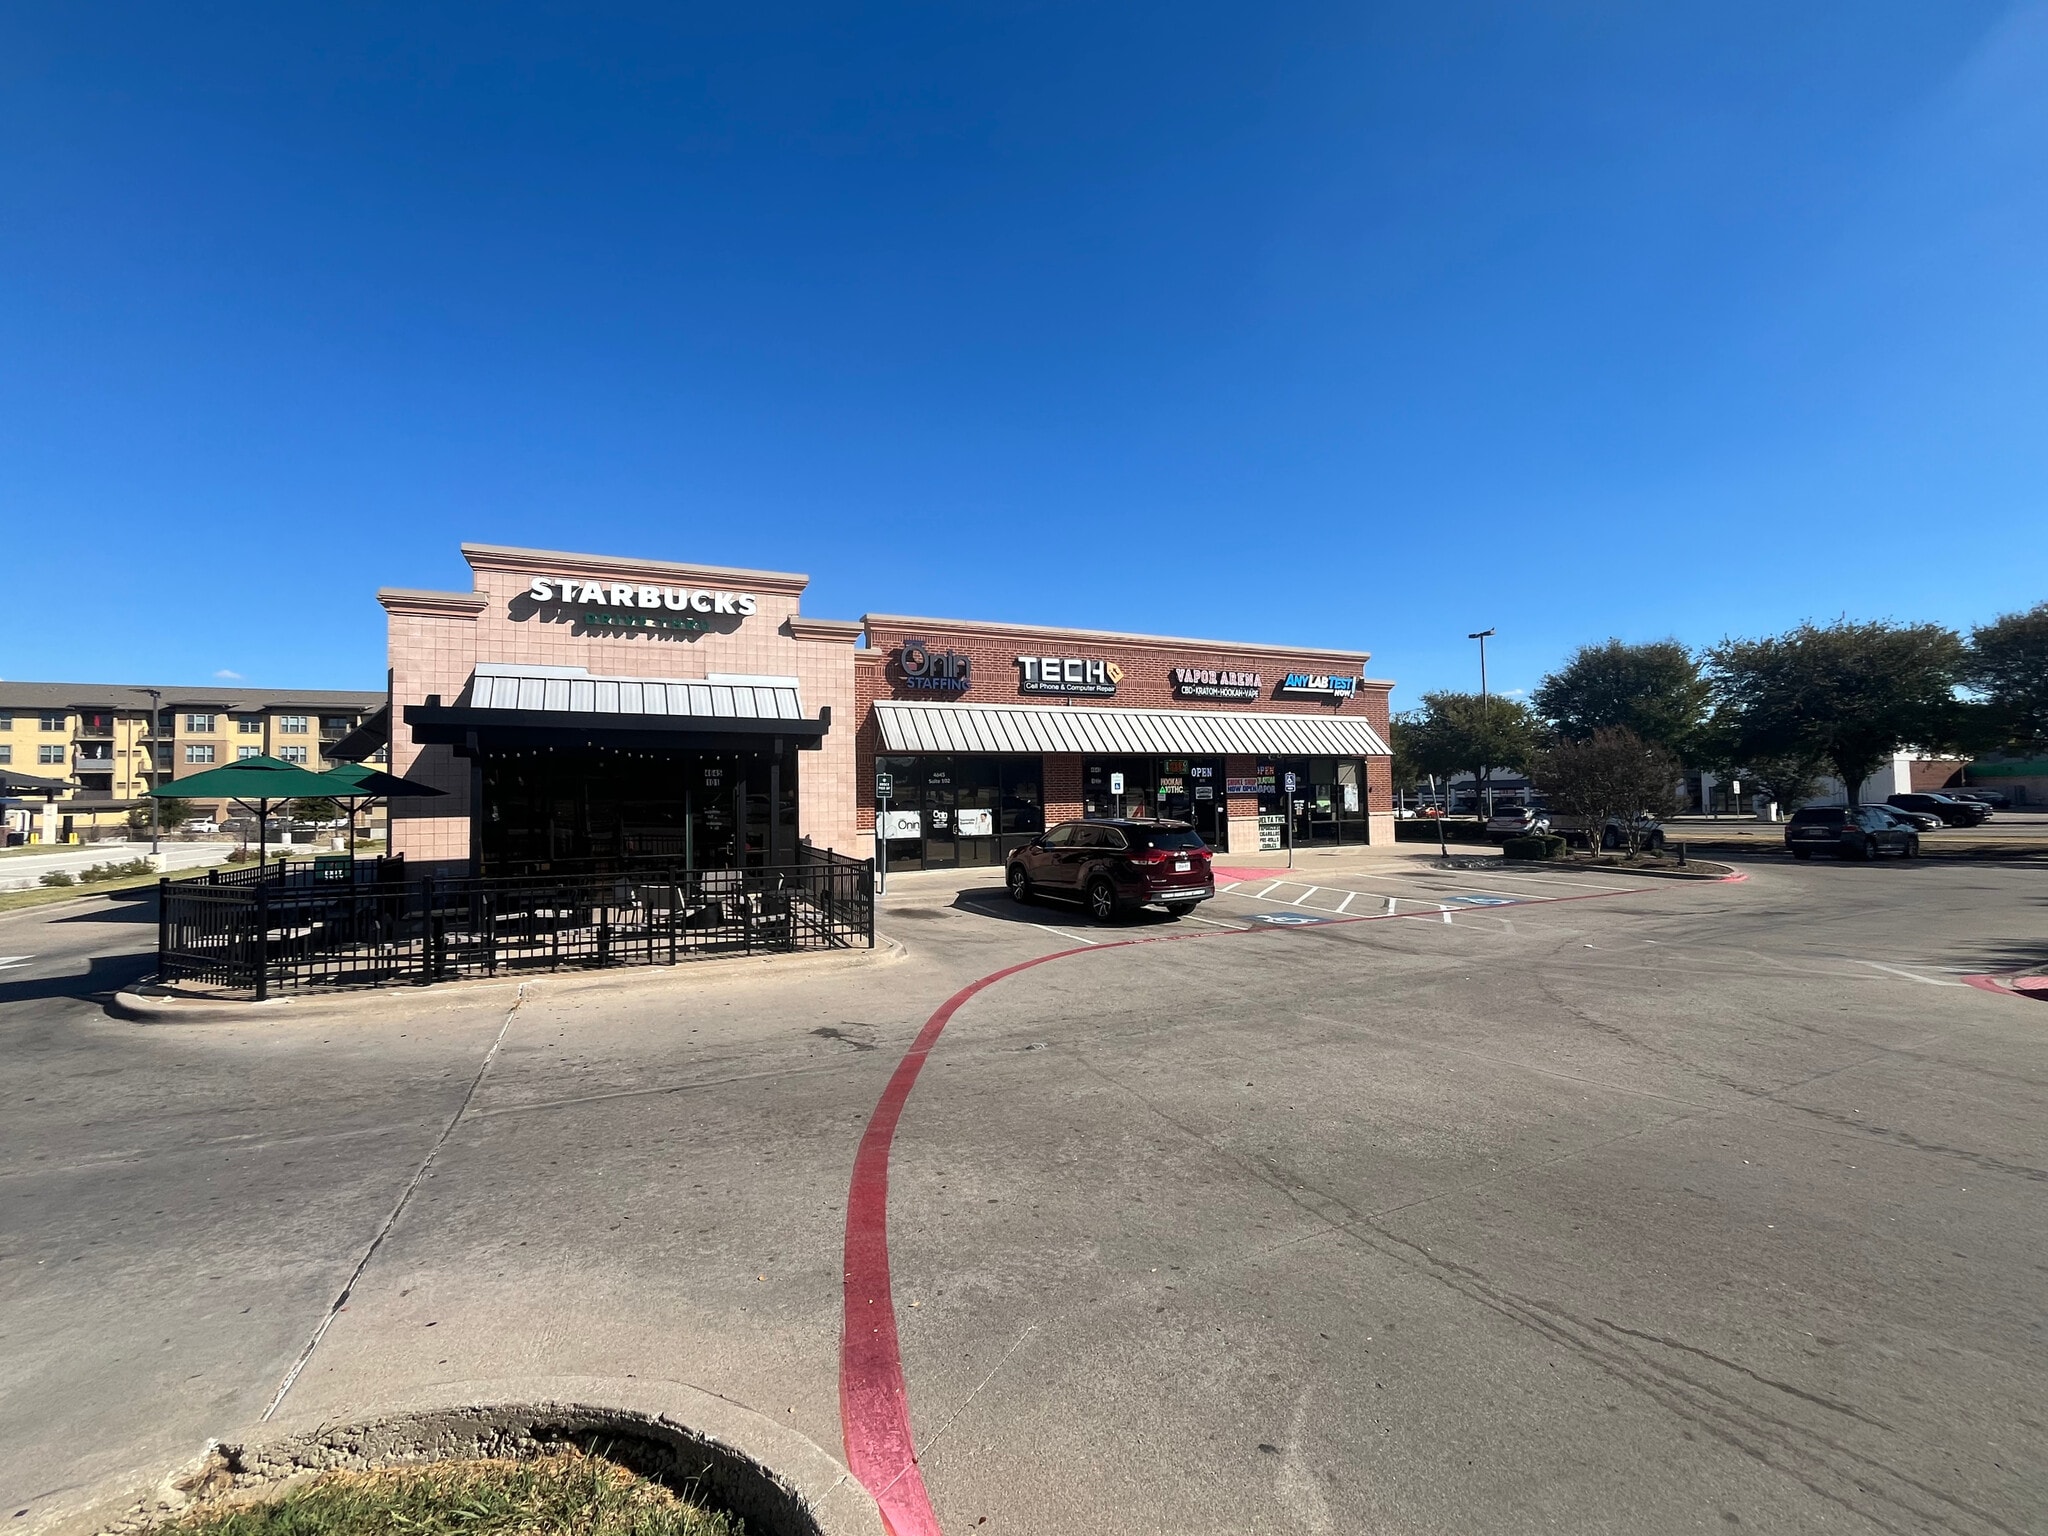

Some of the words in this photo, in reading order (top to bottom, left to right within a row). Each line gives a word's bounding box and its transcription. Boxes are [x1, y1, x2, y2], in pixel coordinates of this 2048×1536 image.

[530, 577, 757, 616] STARBUCKS
[1018, 656, 1105, 683] TECH
[1176, 668, 1218, 685] VAPOR
[1220, 671, 1263, 688] ARENA
[906, 676, 971, 691] STAFFING
[1026, 682, 1038, 690] Cell
[1040, 683, 1059, 691] Phone
[1067, 684, 1095, 693] Computer
[1096, 685, 1115, 693] Repair
[1191, 767, 1213, 778] OPEN
